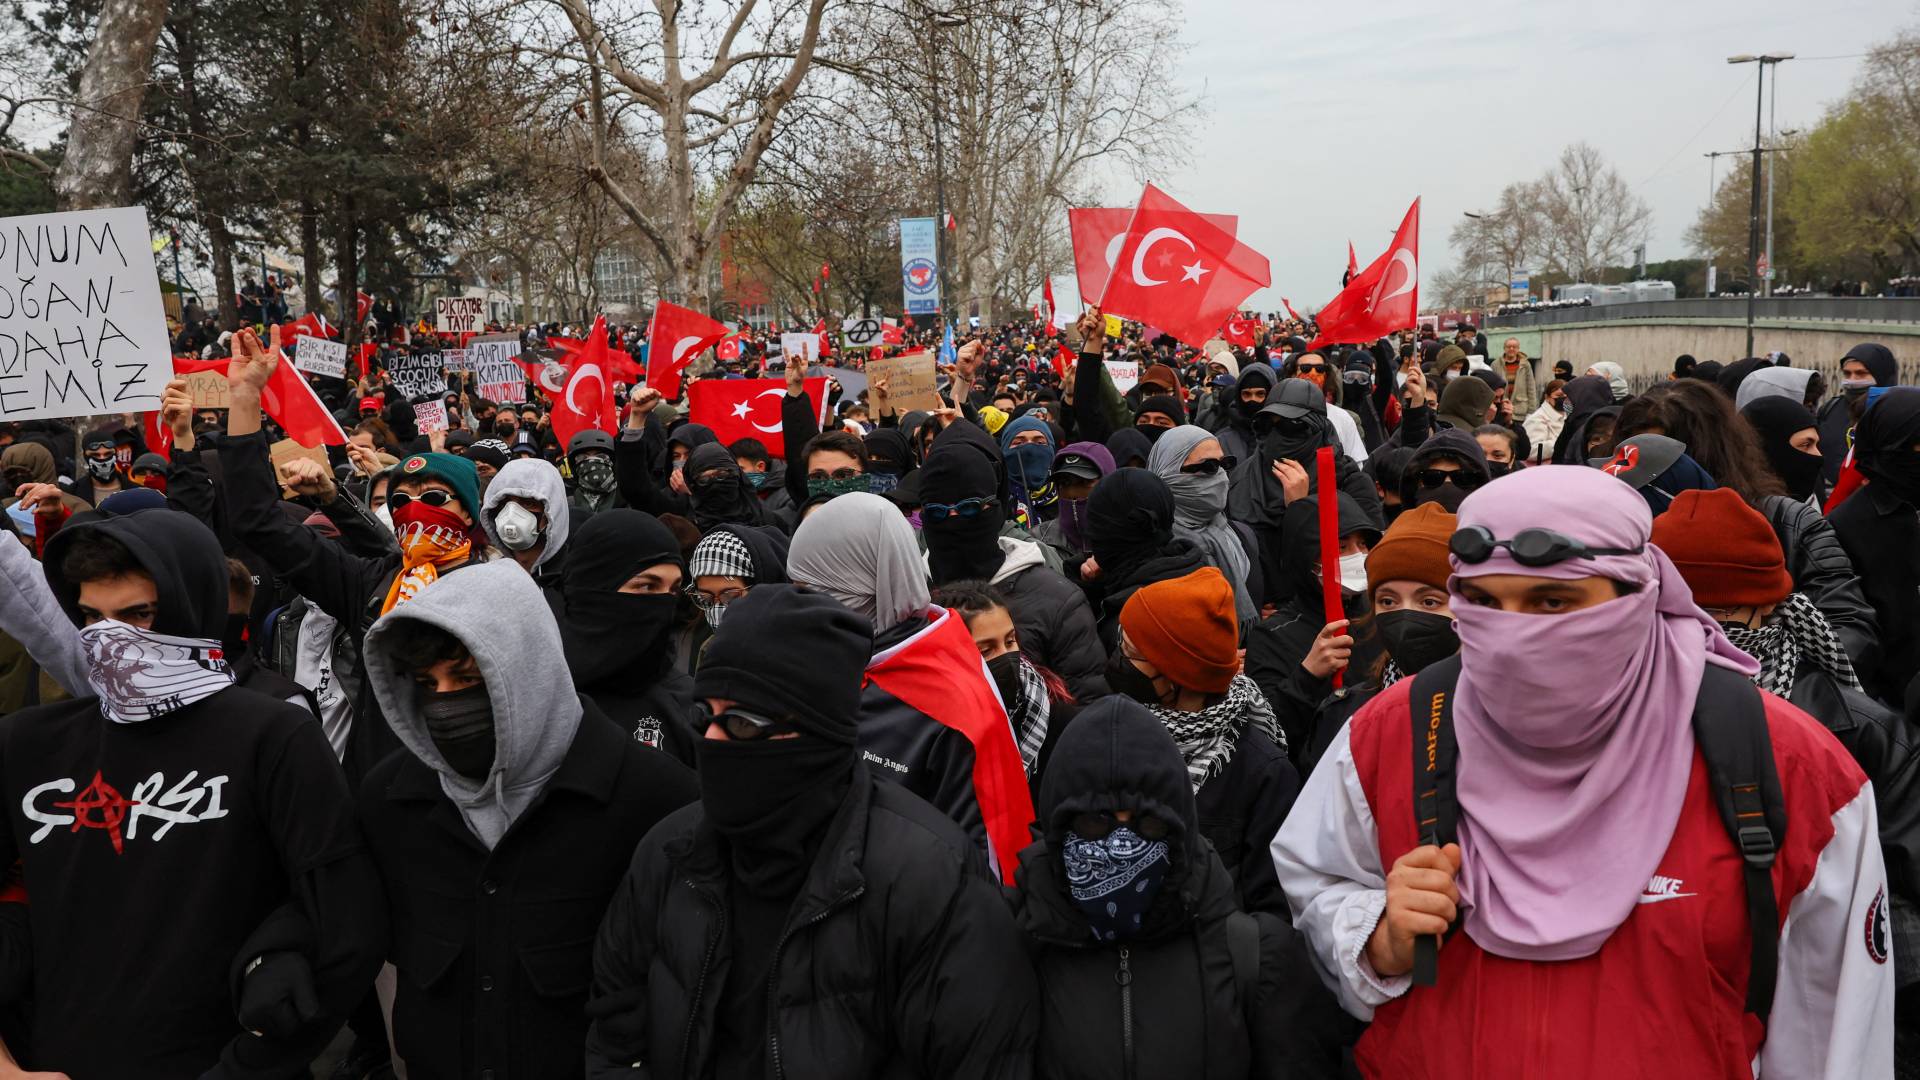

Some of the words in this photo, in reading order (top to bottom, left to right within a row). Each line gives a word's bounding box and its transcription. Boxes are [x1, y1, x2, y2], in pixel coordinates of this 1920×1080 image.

[863, 750, 882, 764] Palm
[883, 757, 909, 773] Angels
[1648, 874, 1684, 896] NIKE
